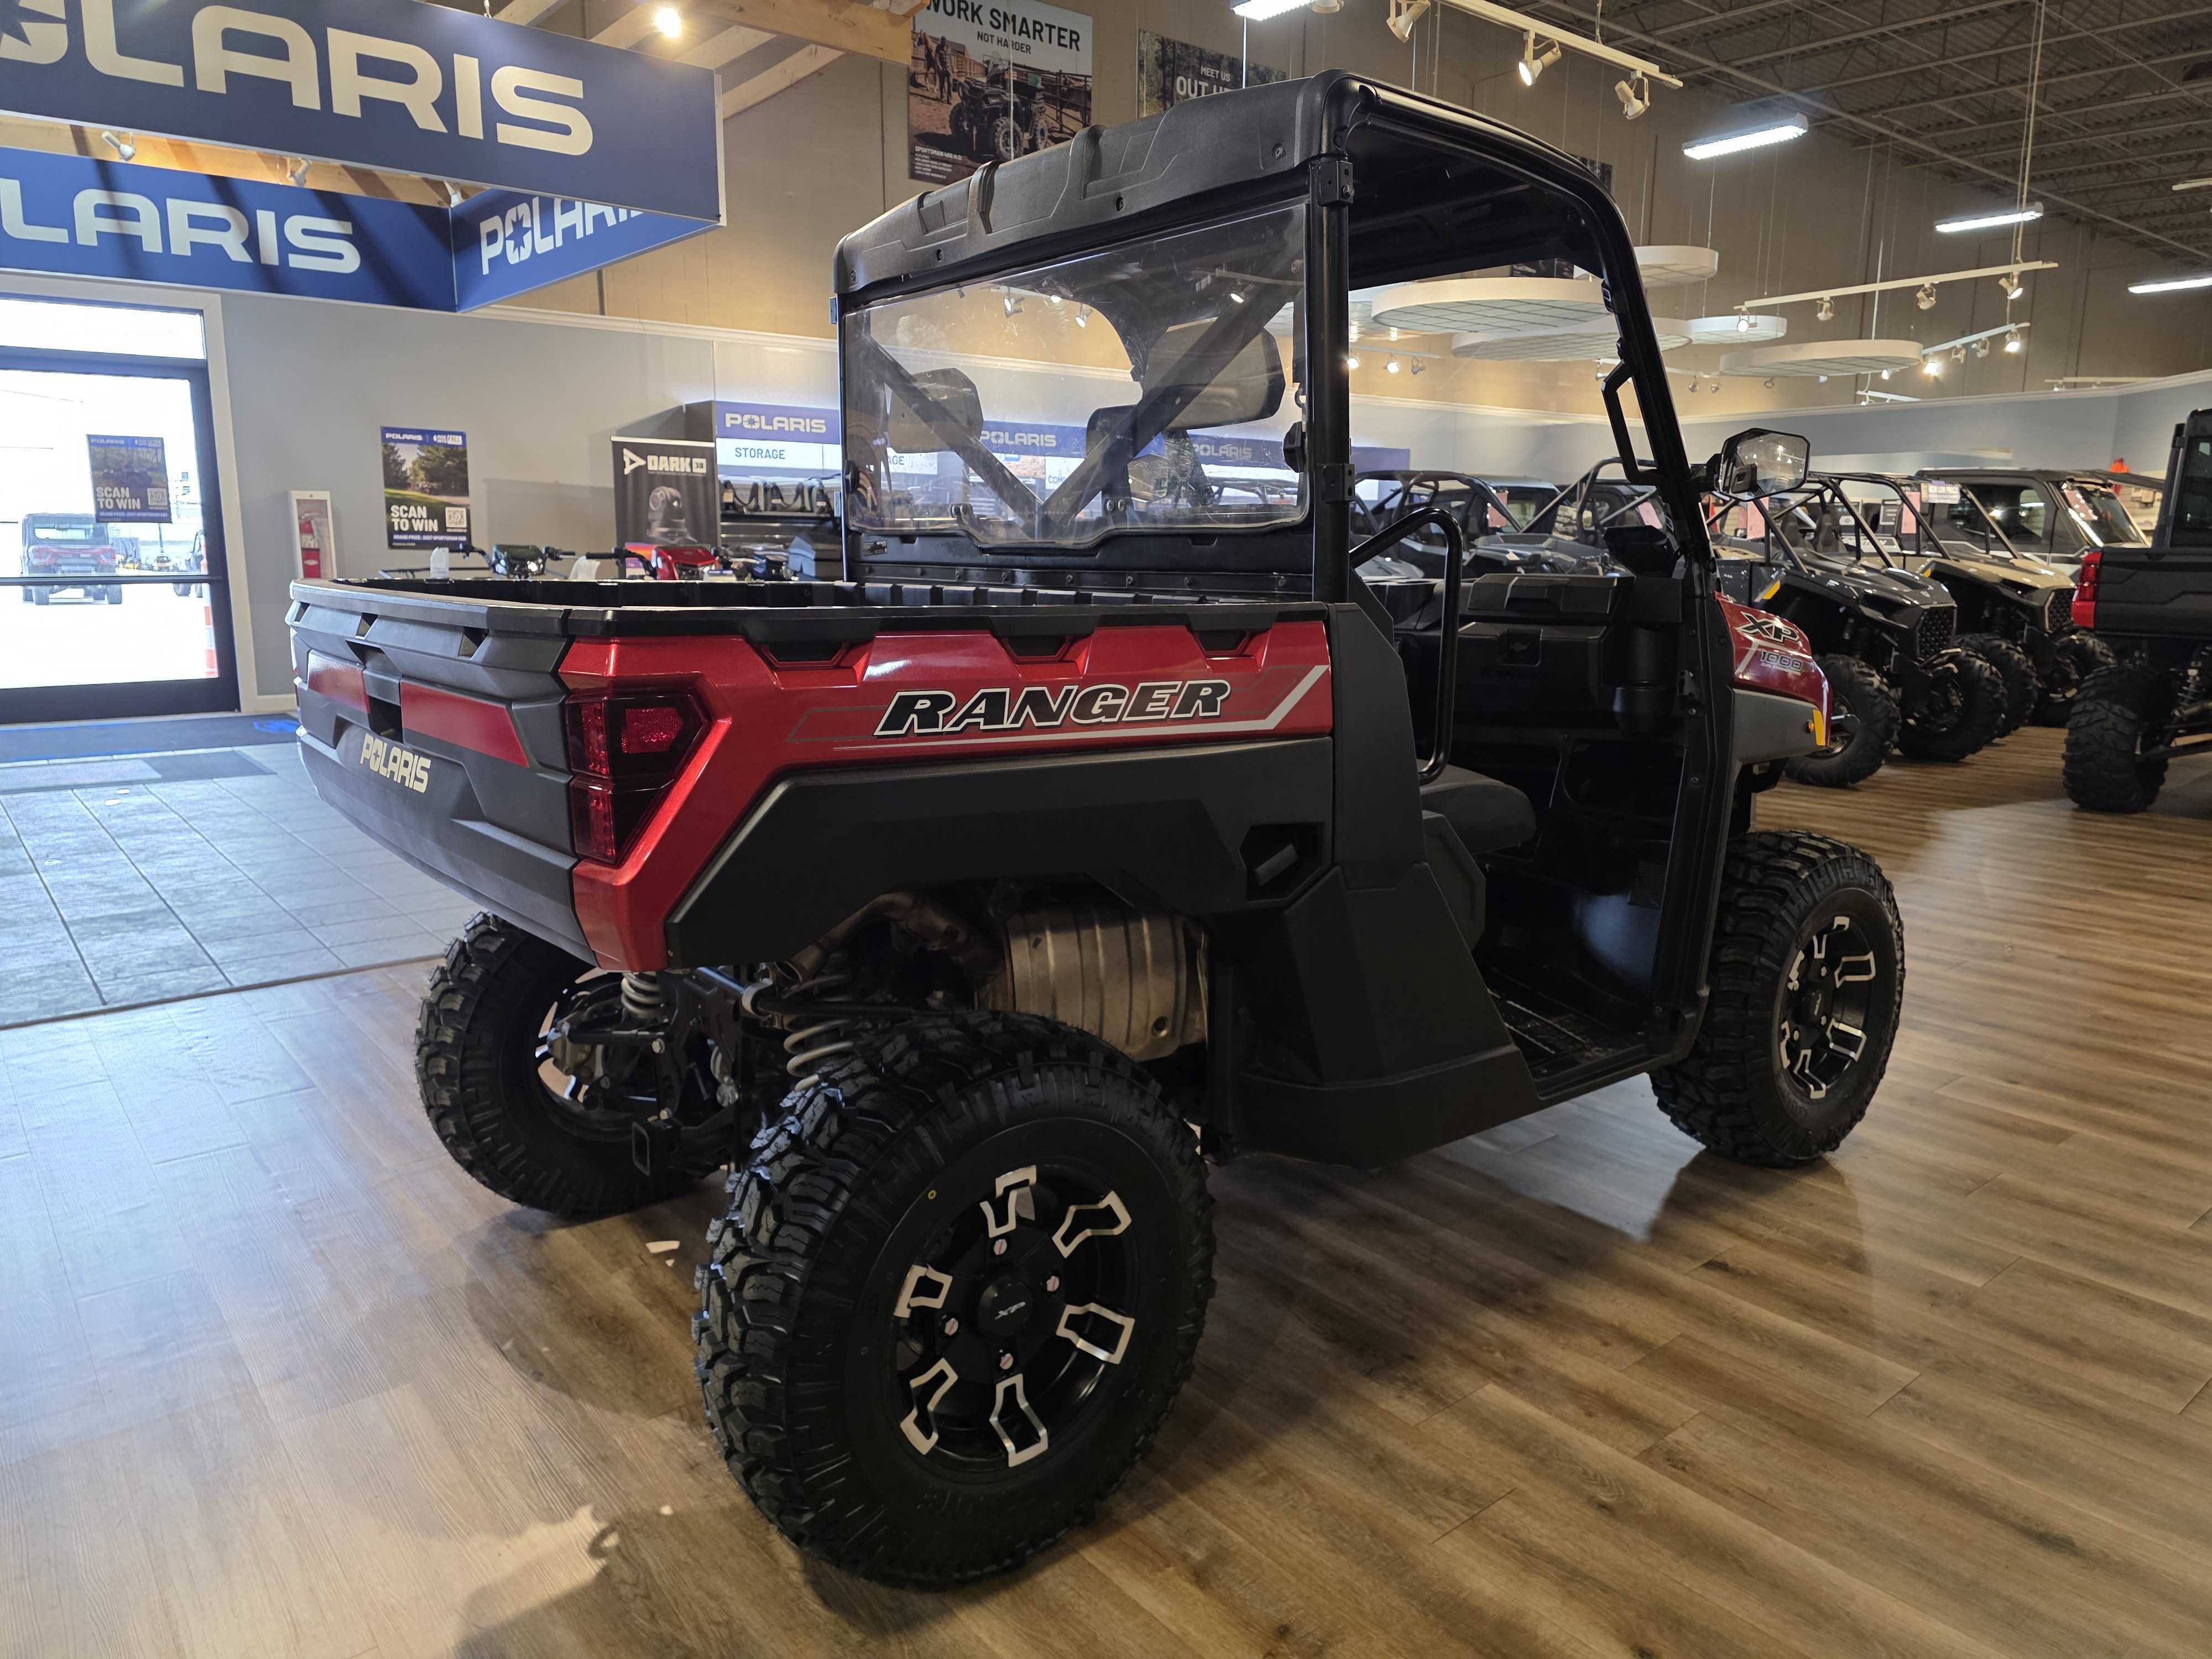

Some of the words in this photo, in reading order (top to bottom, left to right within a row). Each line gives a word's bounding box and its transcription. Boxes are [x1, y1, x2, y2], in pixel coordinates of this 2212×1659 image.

[989, 8, 1081, 51] SMARTER
[977, 31, 995, 45] NOT
[997, 36, 1031, 55] HARDER
[1201, 66, 1219, 79] MEET
[1220, 71, 1231, 82] US
[1176, 76, 1208, 98] OUT
[725, 412, 827, 434] POLARIS
[647, 455, 691, 473] DARK
[734, 447, 786, 460] STORAGE
[96, 486, 131, 498] SCAN
[97, 498, 114, 509] TO
[116, 498, 141, 510] WIN
[390, 504, 427, 519] SCAN
[391, 518, 409, 531] TO
[411, 518, 439, 533] WIN
[1734, 611, 1801, 643] XP
[1760, 649, 1803, 672] 1000
[873, 679, 1232, 738] RANGER
[359, 732, 431, 794] POLARIS
